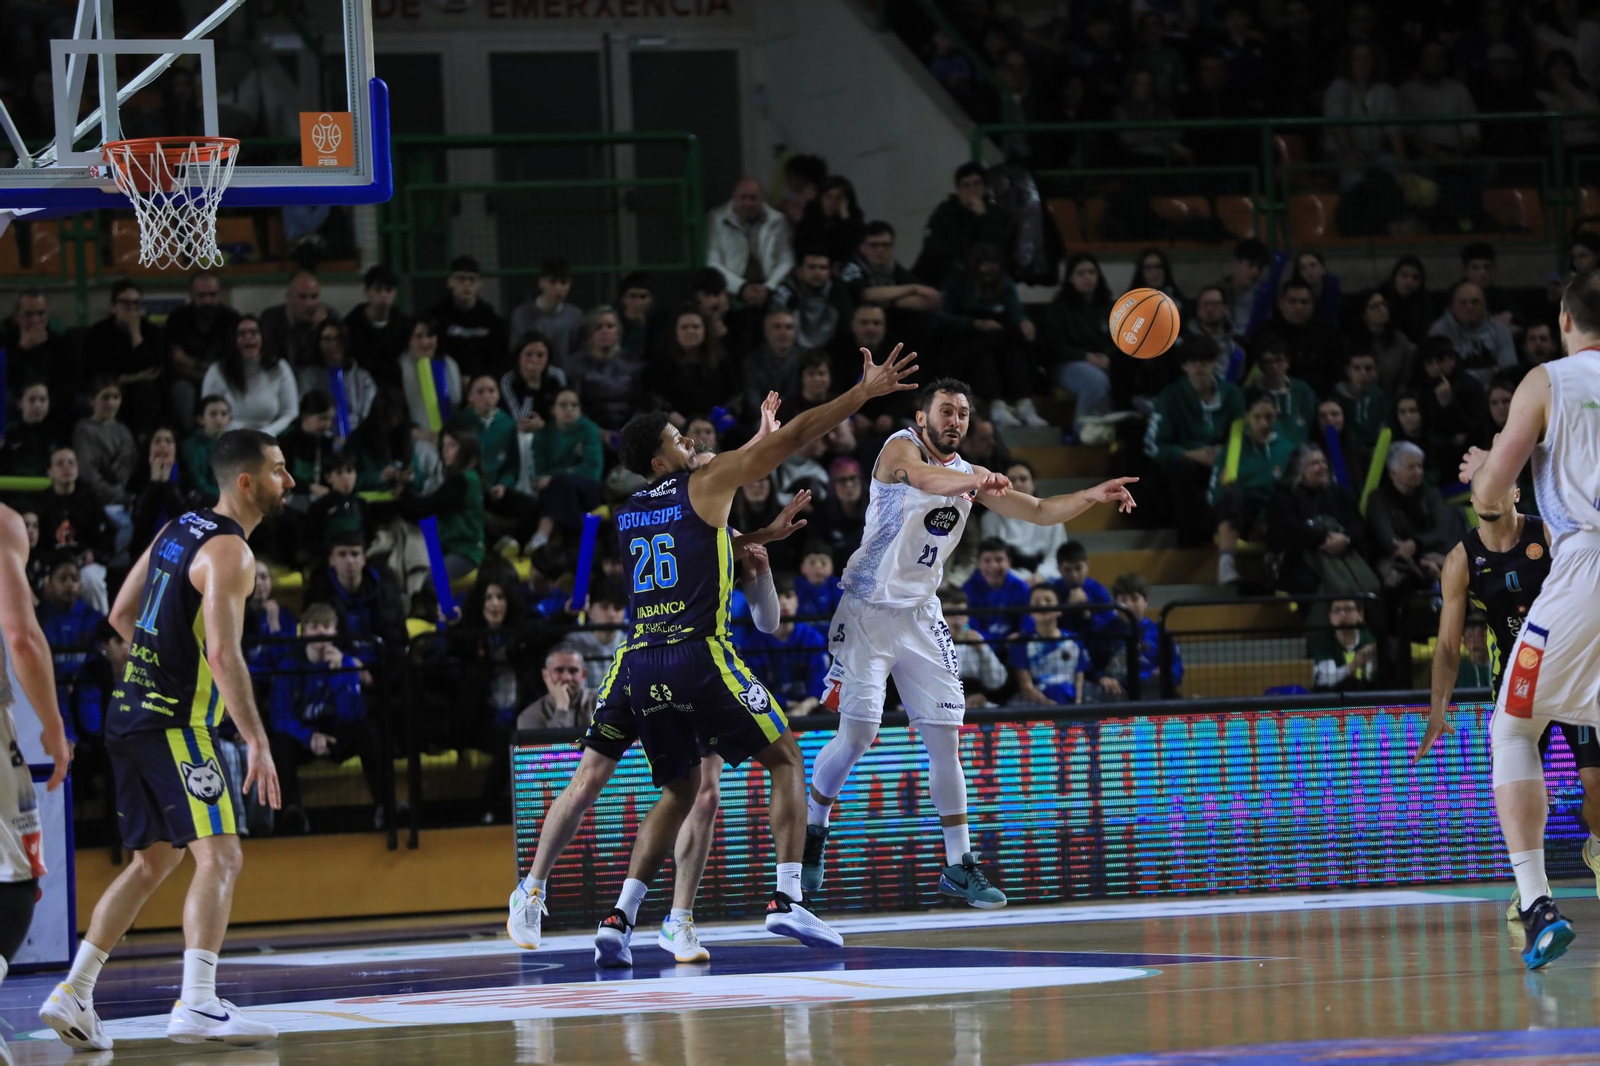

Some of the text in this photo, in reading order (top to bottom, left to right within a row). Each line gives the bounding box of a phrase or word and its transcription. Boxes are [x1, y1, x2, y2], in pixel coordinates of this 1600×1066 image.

[488, 0, 733, 19] EMERXENCIA
[617, 504, 683, 531] OGUNSIPE
[629, 532, 679, 594] 26
[917, 543, 938, 568] 21
